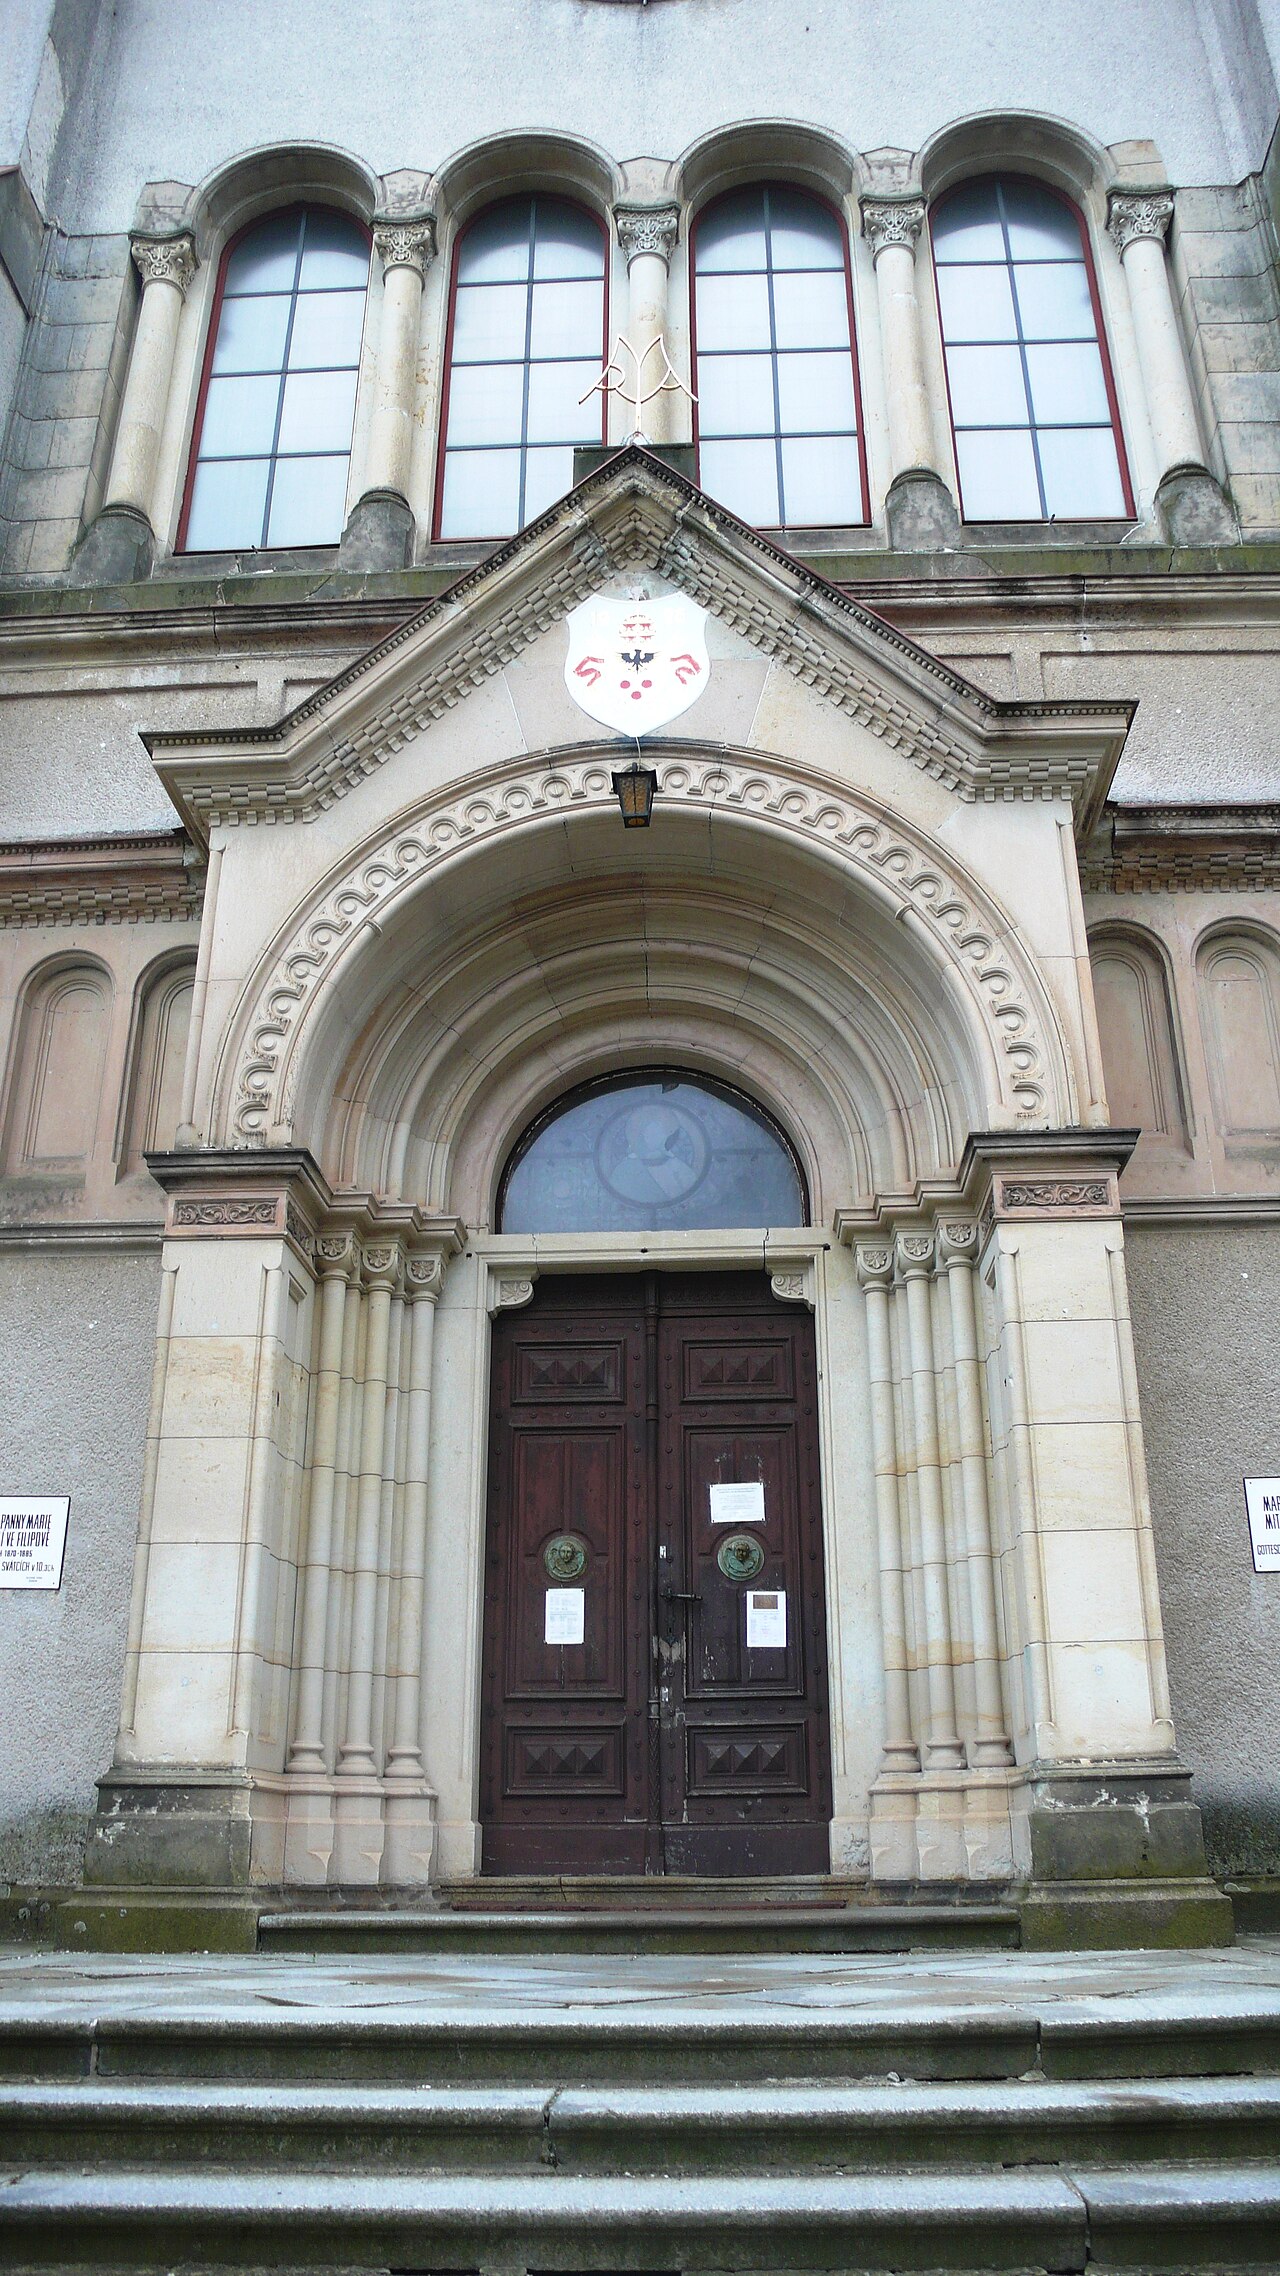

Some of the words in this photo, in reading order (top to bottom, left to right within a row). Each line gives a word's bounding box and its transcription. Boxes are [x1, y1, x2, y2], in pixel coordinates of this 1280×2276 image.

[1, 1514, 26, 1529] PANNY
[26, 1514, 52, 1529] MARIE
[7, 1532, 15, 1547] VE
